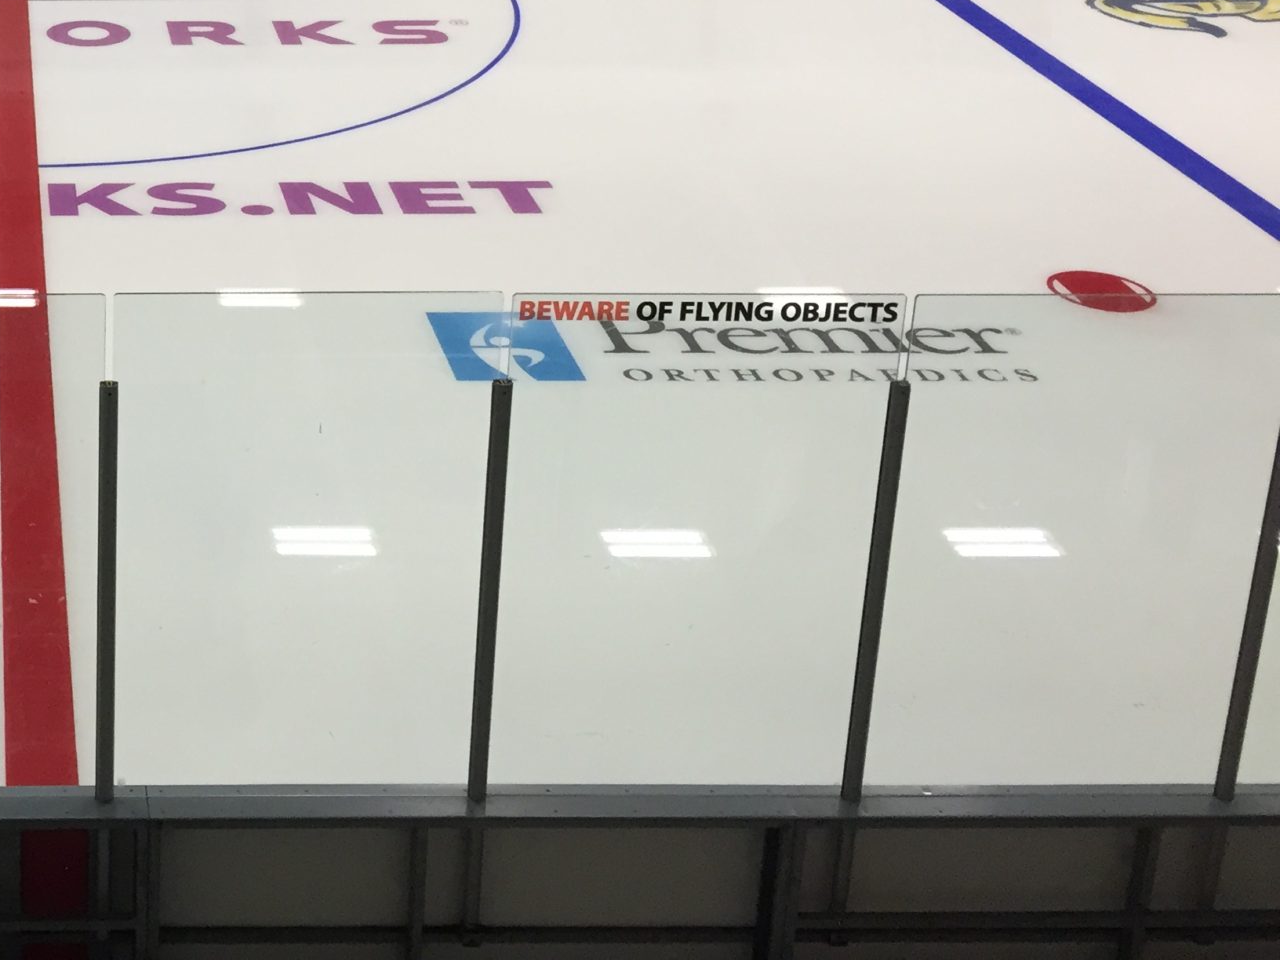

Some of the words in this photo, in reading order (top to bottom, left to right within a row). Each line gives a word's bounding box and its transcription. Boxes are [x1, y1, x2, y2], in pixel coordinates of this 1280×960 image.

[519, 300, 630, 321] BEWARE
[636, 301, 673, 321] OF
[679, 301, 774, 322] FLYING
[780, 302, 898, 322] OBJECTS
[598, 319, 1010, 355] Premier
